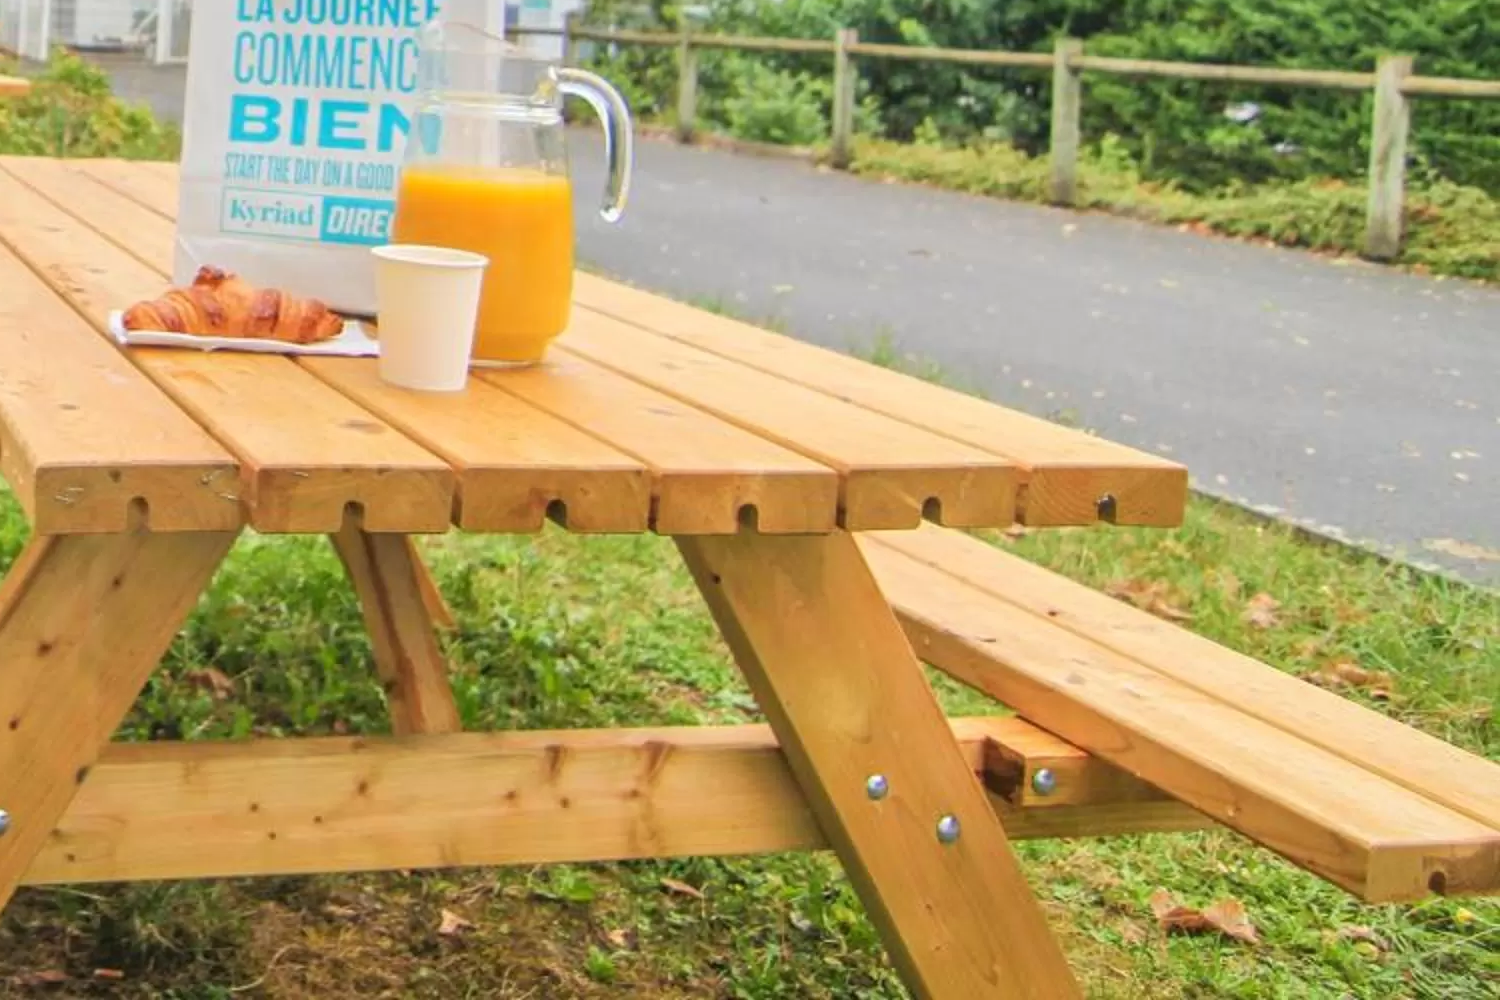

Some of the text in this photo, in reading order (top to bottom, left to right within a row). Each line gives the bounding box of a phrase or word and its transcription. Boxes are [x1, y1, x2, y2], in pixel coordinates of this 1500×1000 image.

[233, 30, 420, 93] COMMENC
[228, 93, 443, 154] BIEN
[225, 152, 394, 190] START THE DAY ON A GOOD
[230, 198, 314, 228] Kyriad
